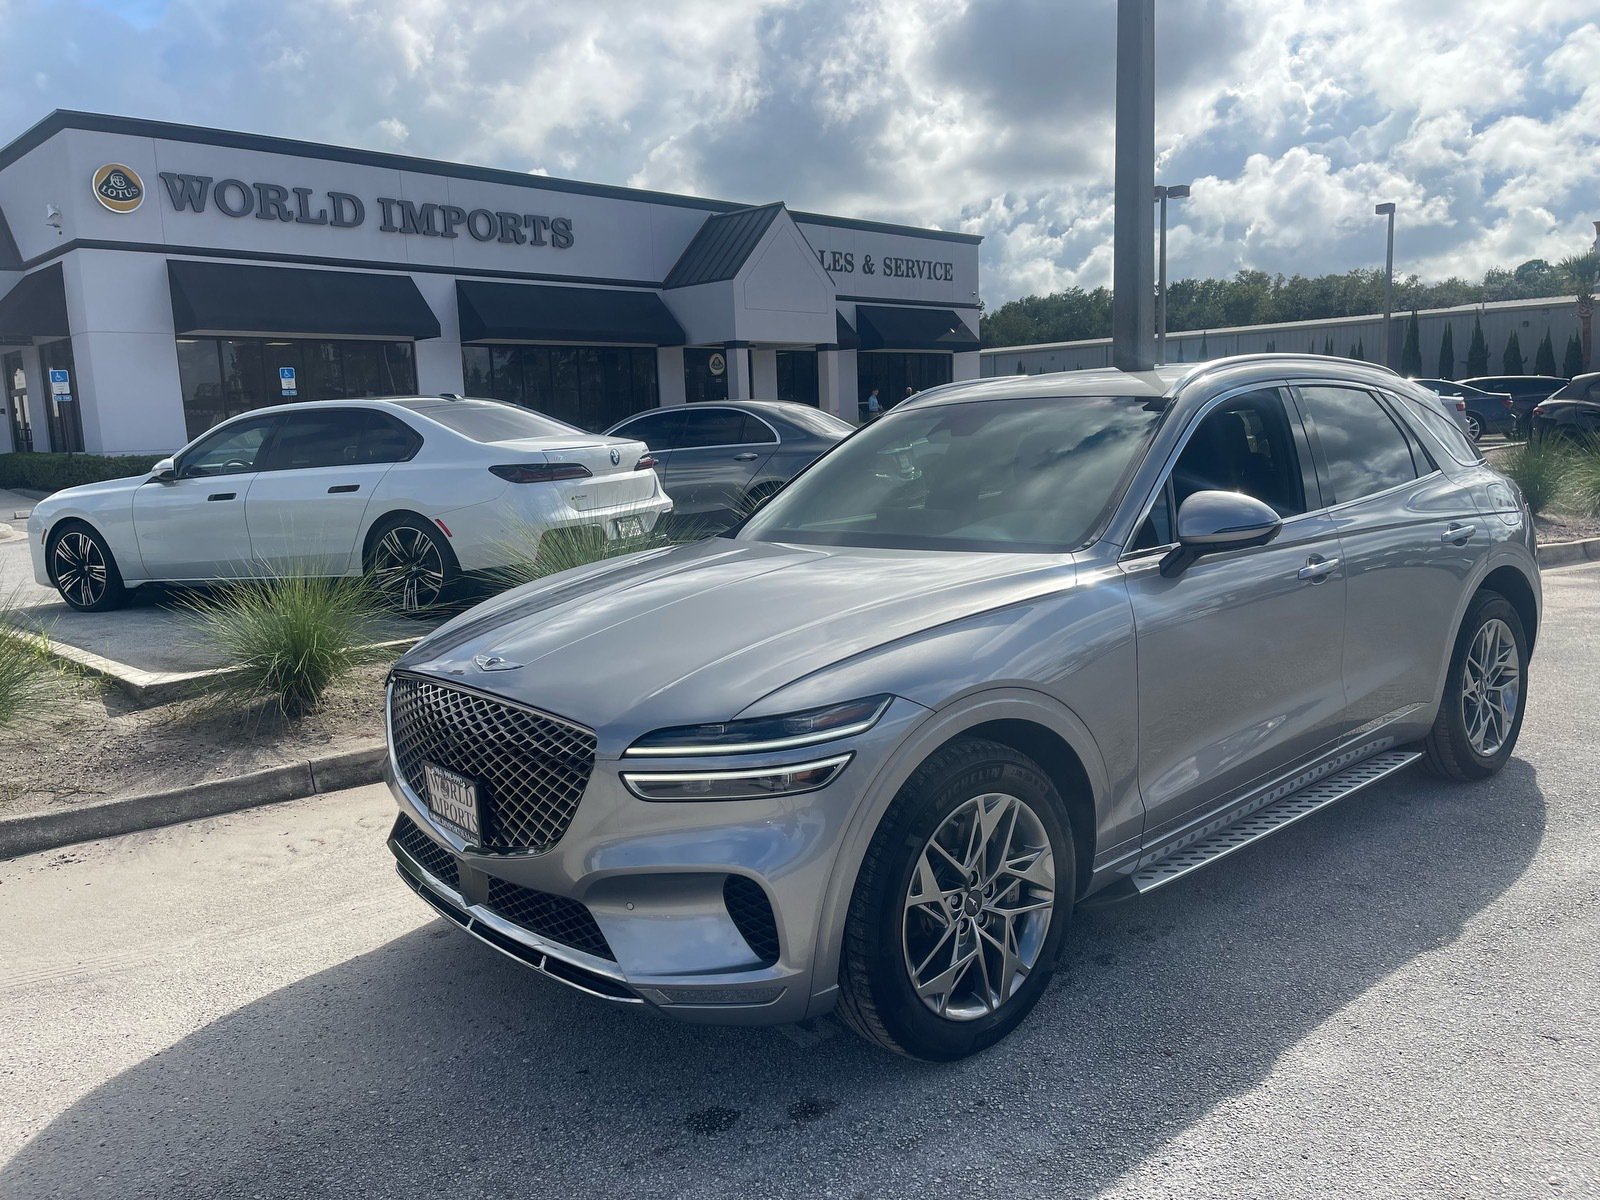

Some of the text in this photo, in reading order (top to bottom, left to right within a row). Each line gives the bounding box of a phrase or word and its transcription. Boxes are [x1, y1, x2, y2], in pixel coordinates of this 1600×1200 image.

[101, 185, 139, 198] LOTUS
[159, 171, 575, 250] WORLD IMPORTS
[862, 254, 876, 275] &
[883, 256, 953, 282] SERVICE
[428, 772, 473, 808] WORLD
[935, 766, 1001, 810] MICHELIN
[431, 794, 479, 835] IMPORTS
